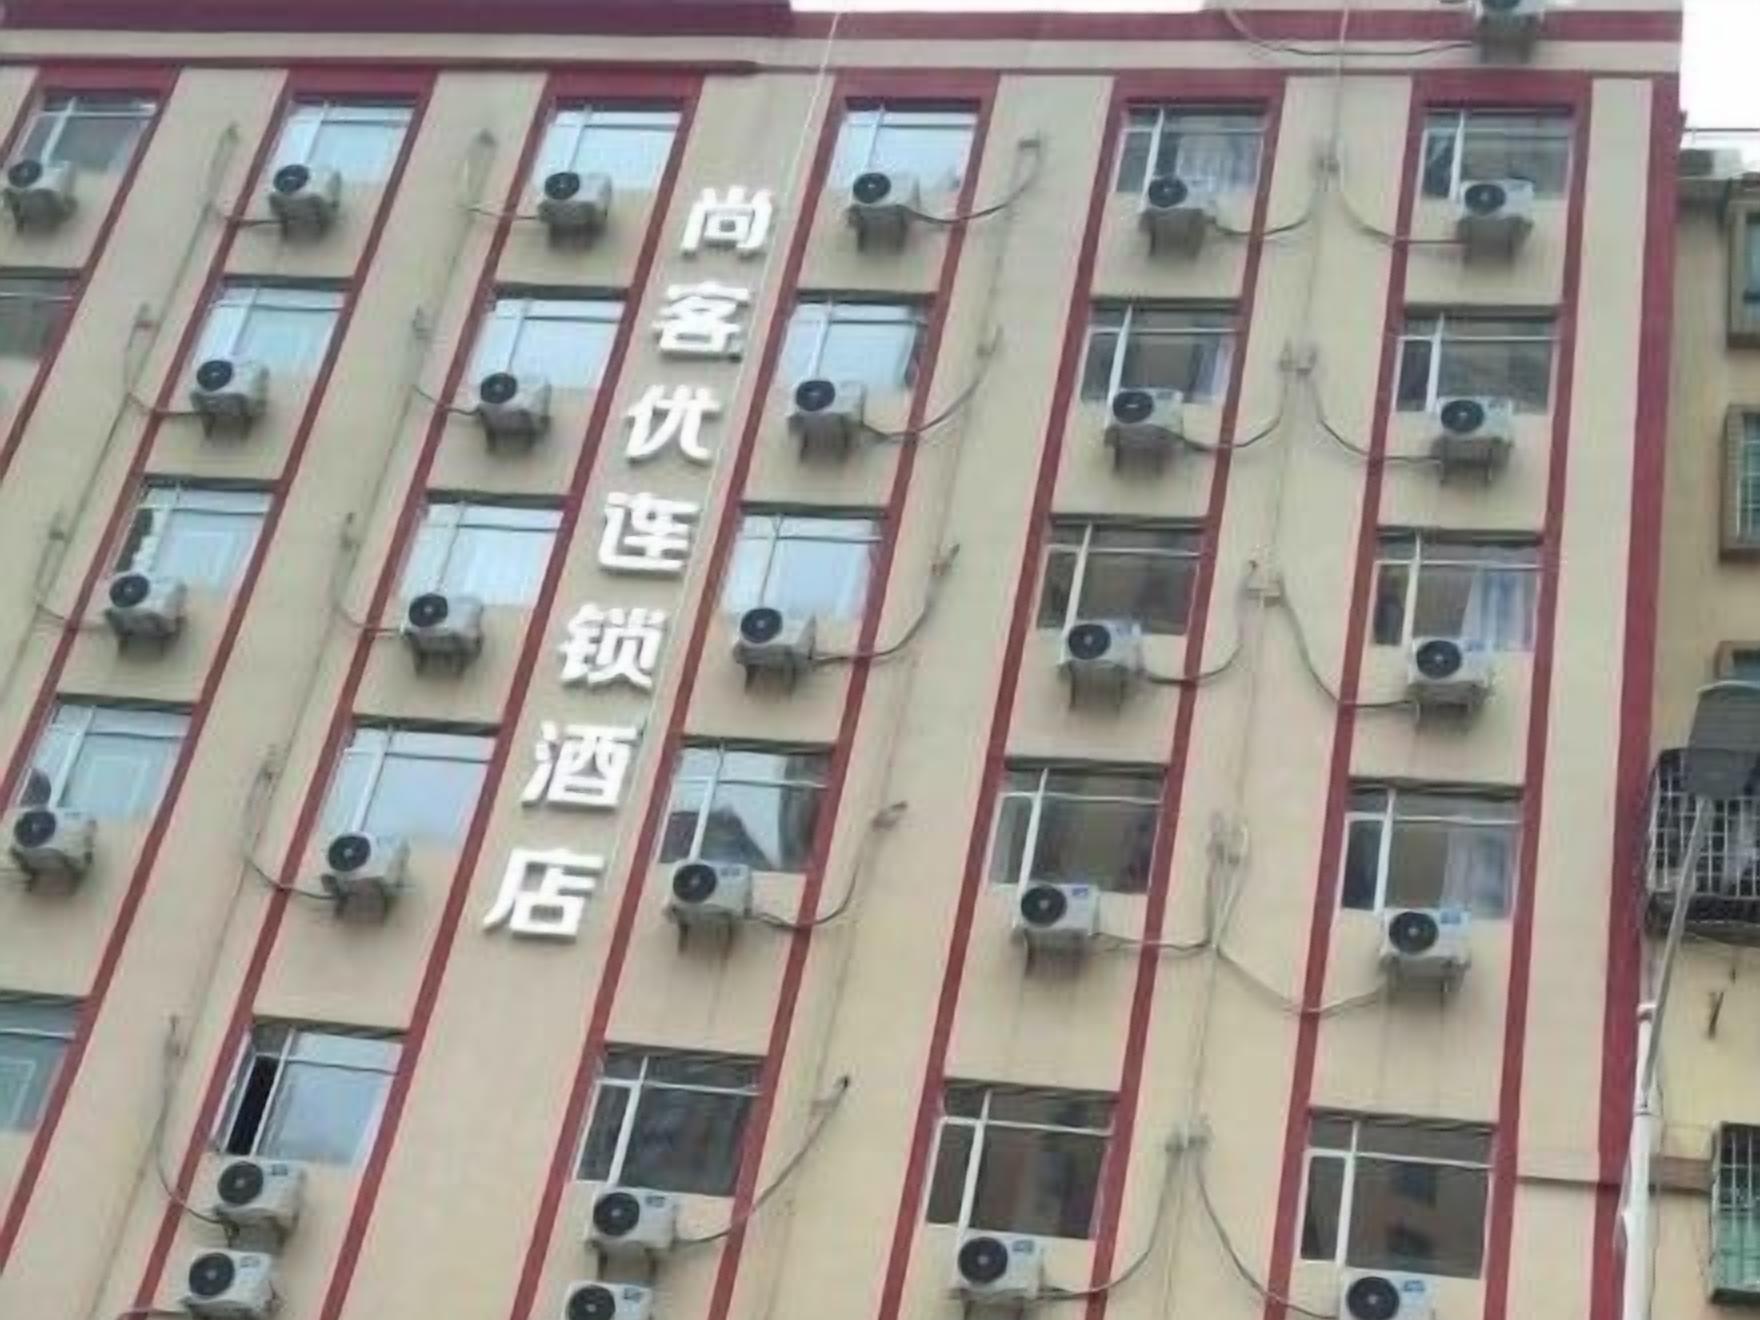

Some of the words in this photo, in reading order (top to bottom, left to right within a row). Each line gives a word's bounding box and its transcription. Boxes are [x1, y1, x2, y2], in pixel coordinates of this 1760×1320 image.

[484, 186, 774, 942] 尚客优连锁酒店
